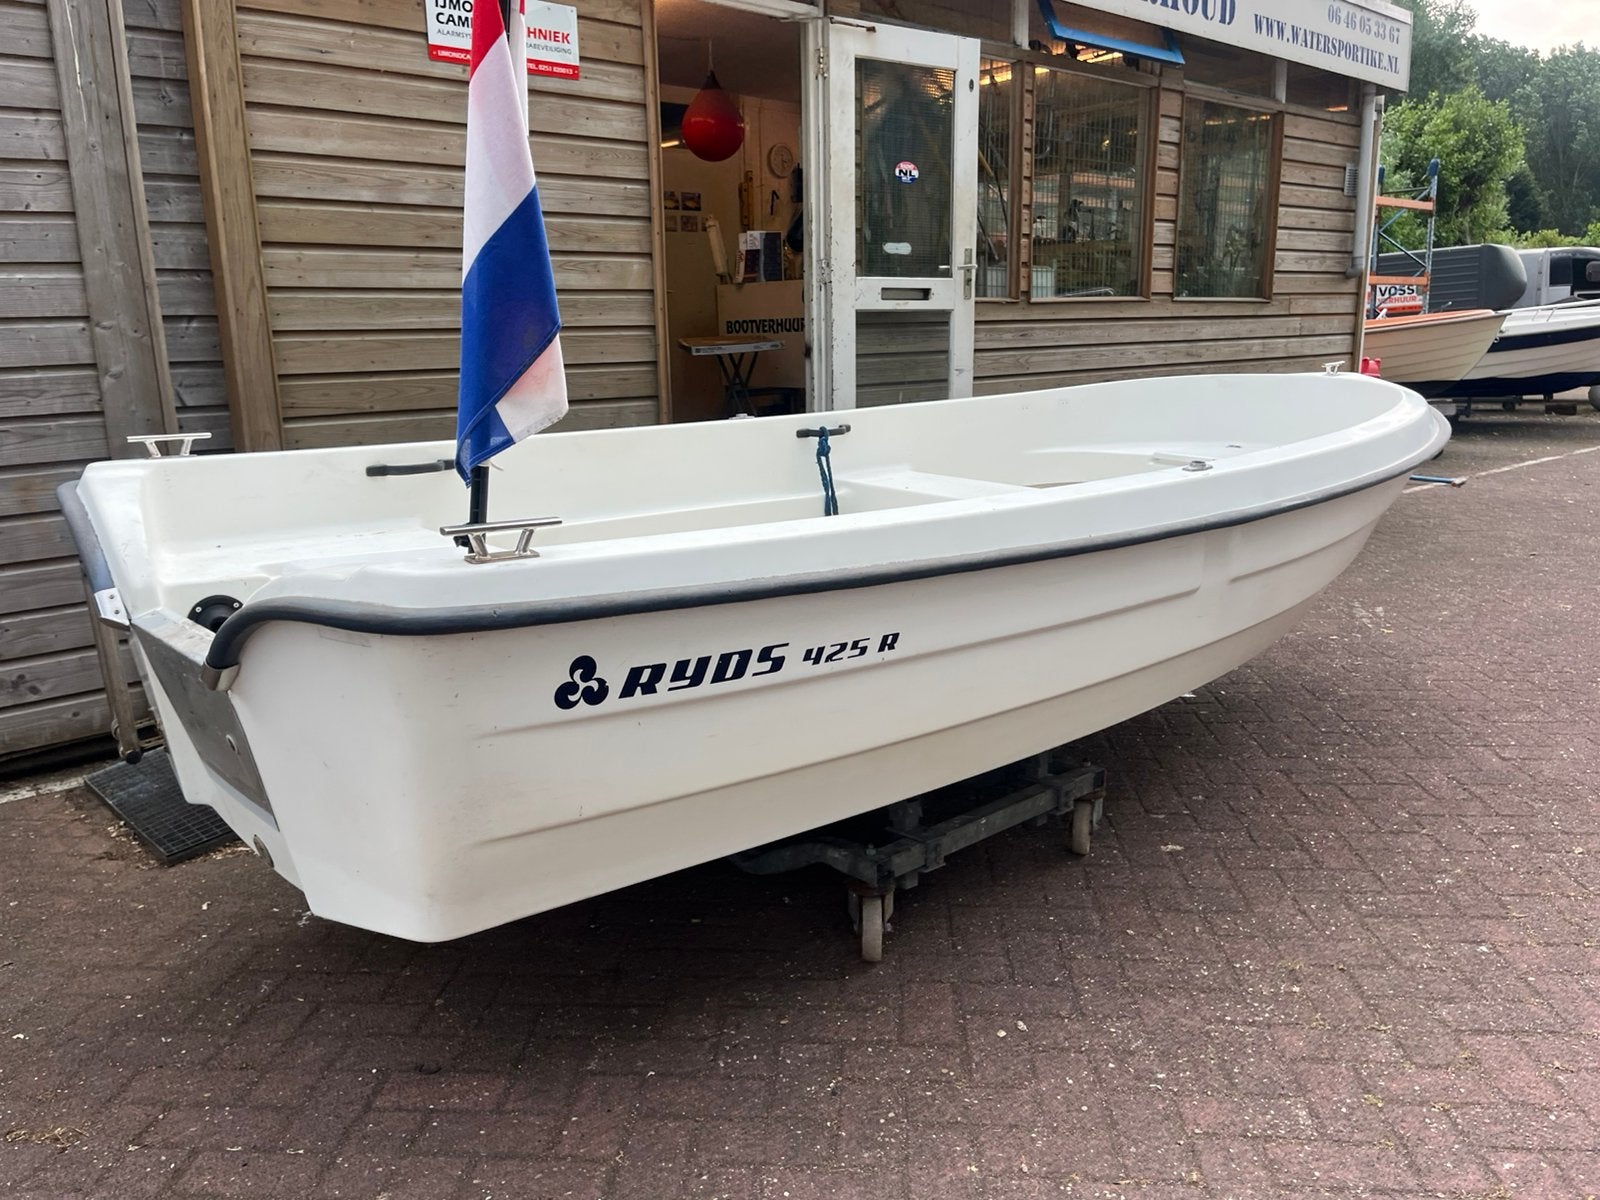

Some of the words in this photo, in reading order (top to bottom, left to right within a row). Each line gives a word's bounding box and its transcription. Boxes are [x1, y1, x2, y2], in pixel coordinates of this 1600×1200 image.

[1327, 4, 1341, 25] 06
[1344, 11, 1357, 30] 46
[1359, 15, 1372, 36] 05
[1374, 20, 1387, 41] 33
[1389, 25, 1401, 45] 67
[527, 26, 571, 44] HNIEK
[1254, 13, 1400, 75] WWW.WATERSPORTIKE.NL
[898, 169, 916, 177] NL
[1377, 295, 1417, 303] VRHUUR
[1378, 285, 1415, 297] VOSS
[617, 642, 790, 700] RYDS
[802, 637, 870, 667] 425
[877, 632, 901, 653] R
